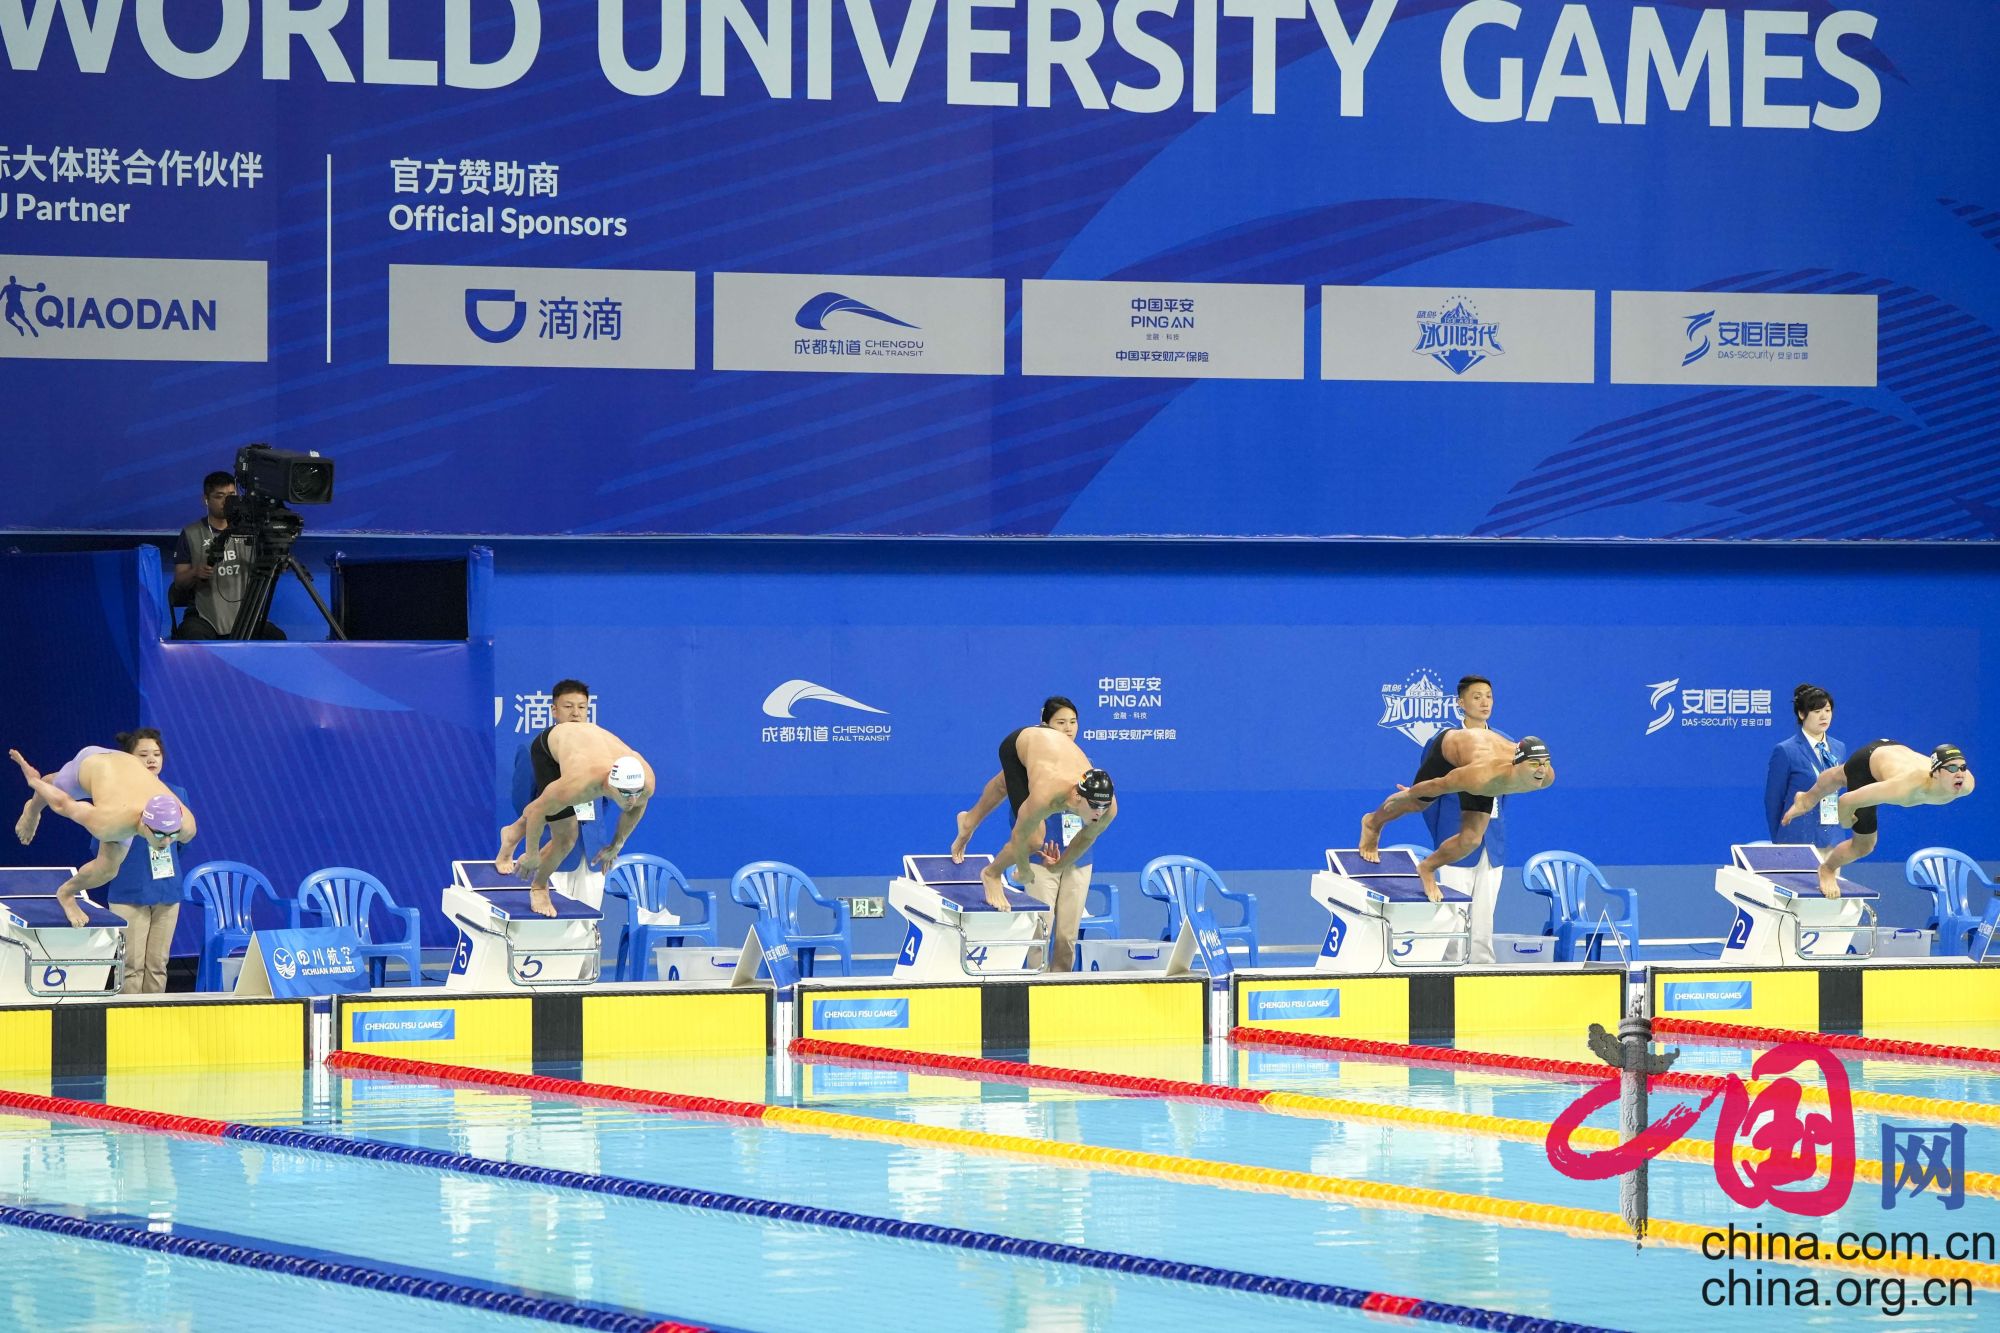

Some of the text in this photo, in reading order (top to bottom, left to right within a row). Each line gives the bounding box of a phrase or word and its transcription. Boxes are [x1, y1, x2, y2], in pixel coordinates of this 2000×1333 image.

[598, 0, 1393, 117] UNIVERSITY
[1440, 0, 1882, 132] GAMES
[390, 157, 560, 198] 官方赞助商
[16, 193, 131, 223] Partner
[388, 204, 627, 239] Official Sponsors
[35, 295, 217, 331] QIAODAN
[1131, 297, 1194, 313] 中国平安
[538, 296, 623, 341] 滴滴
[865, 340, 924, 349] CHENGDU
[1415, 323, 1503, 351] 冰川时代
[1718, 321, 1808, 347] 安恒信息
[794, 338, 861, 356] 成都轨道
[1115, 350, 1209, 362] 中国平安财产保险
[1718, 350, 1775, 362] DAS-security
[217, 564, 240, 576] 067
[1098, 677, 1161, 691] 中国平安
[1681, 689, 1772, 714] 安恒信息
[832, 725, 891, 734] CHENGDU
[1681, 716, 1738, 729] DAS-security
[762, 726, 829, 742] 成都轨道
[1083, 729, 1176, 741] 中国平安财产保险
[1329, 926, 1339, 952] 3
[1736, 919, 1746, 944] 2
[905, 936, 915, 961] 4
[1392, 931, 1415, 956] 3
[1800, 931, 1820, 954] 2
[459, 942, 467, 968] 5
[966, 946, 988, 966] 4
[43, 965, 67, 987] 6
[301, 965, 356, 976] SICHUAN AIRLINES
[519, 955, 543, 978] 5
[1259, 999, 1329, 1009] CHENGDU FISU GAMES
[1674, 991, 1742, 1000] CHENGDU FISU GAMES
[824, 1009, 898, 1019] CHENGDU FISU GAMES
[364, 1020, 443, 1031] CHENGDU FISU GAMES
